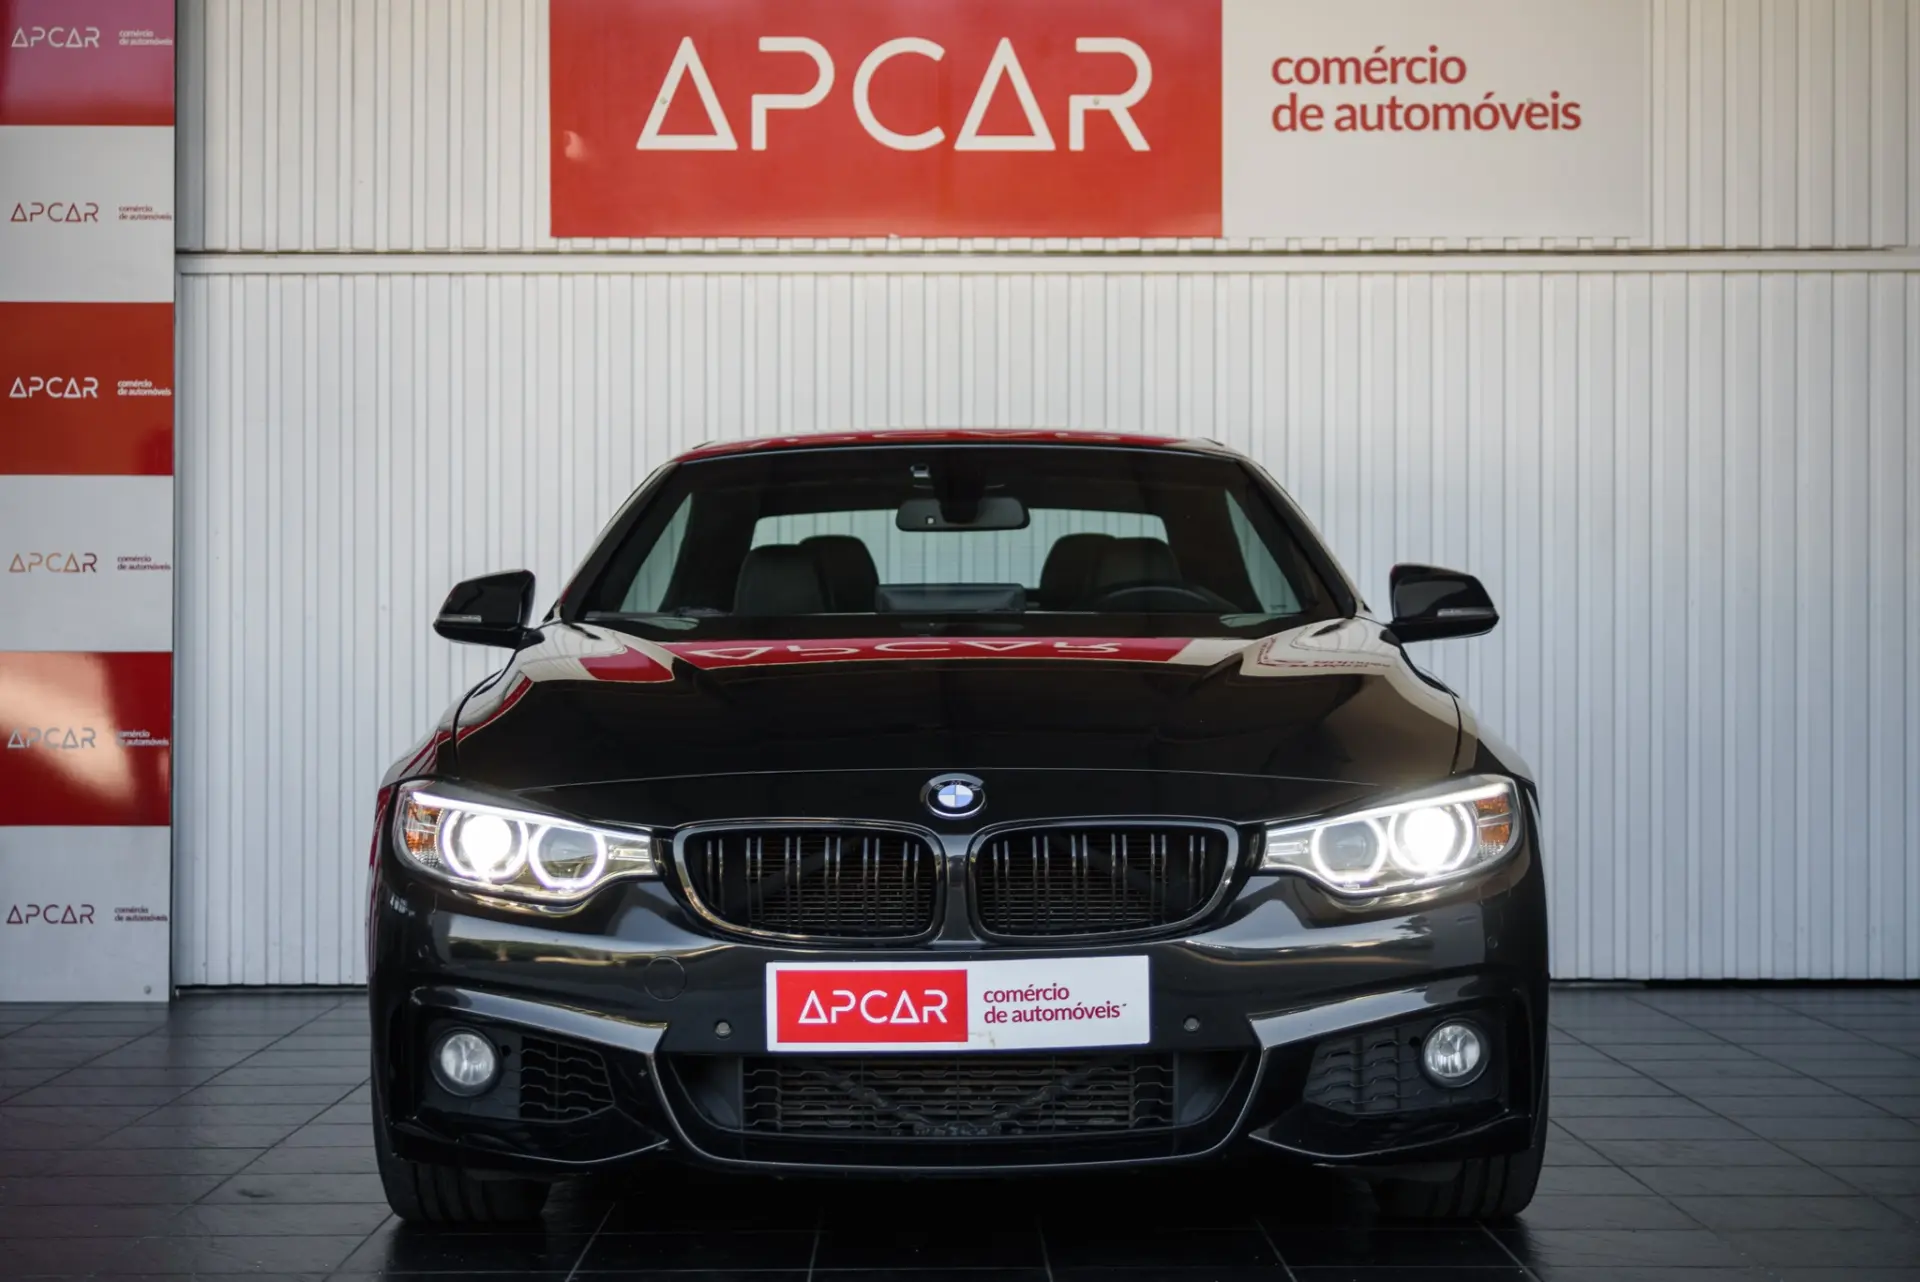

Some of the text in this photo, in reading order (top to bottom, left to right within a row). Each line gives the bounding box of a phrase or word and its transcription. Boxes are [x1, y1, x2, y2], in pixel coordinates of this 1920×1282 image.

[11, 27, 100, 48] APCAR
[1271, 45, 1467, 85] comércio
[636, 36, 1152, 151] APCAR
[1271, 91, 1582, 131] de automóveis
[10, 202, 99, 222] APCAR
[9, 376, 99, 399] APCAR
[9, 552, 98, 573] APCAR
[7, 727, 96, 749] APCAR
[6, 904, 95, 924] APCAR
[983, 982, 1070, 1003] comércio
[798, 989, 949, 1025] APCAR
[984, 1005, 1008, 1024] de
